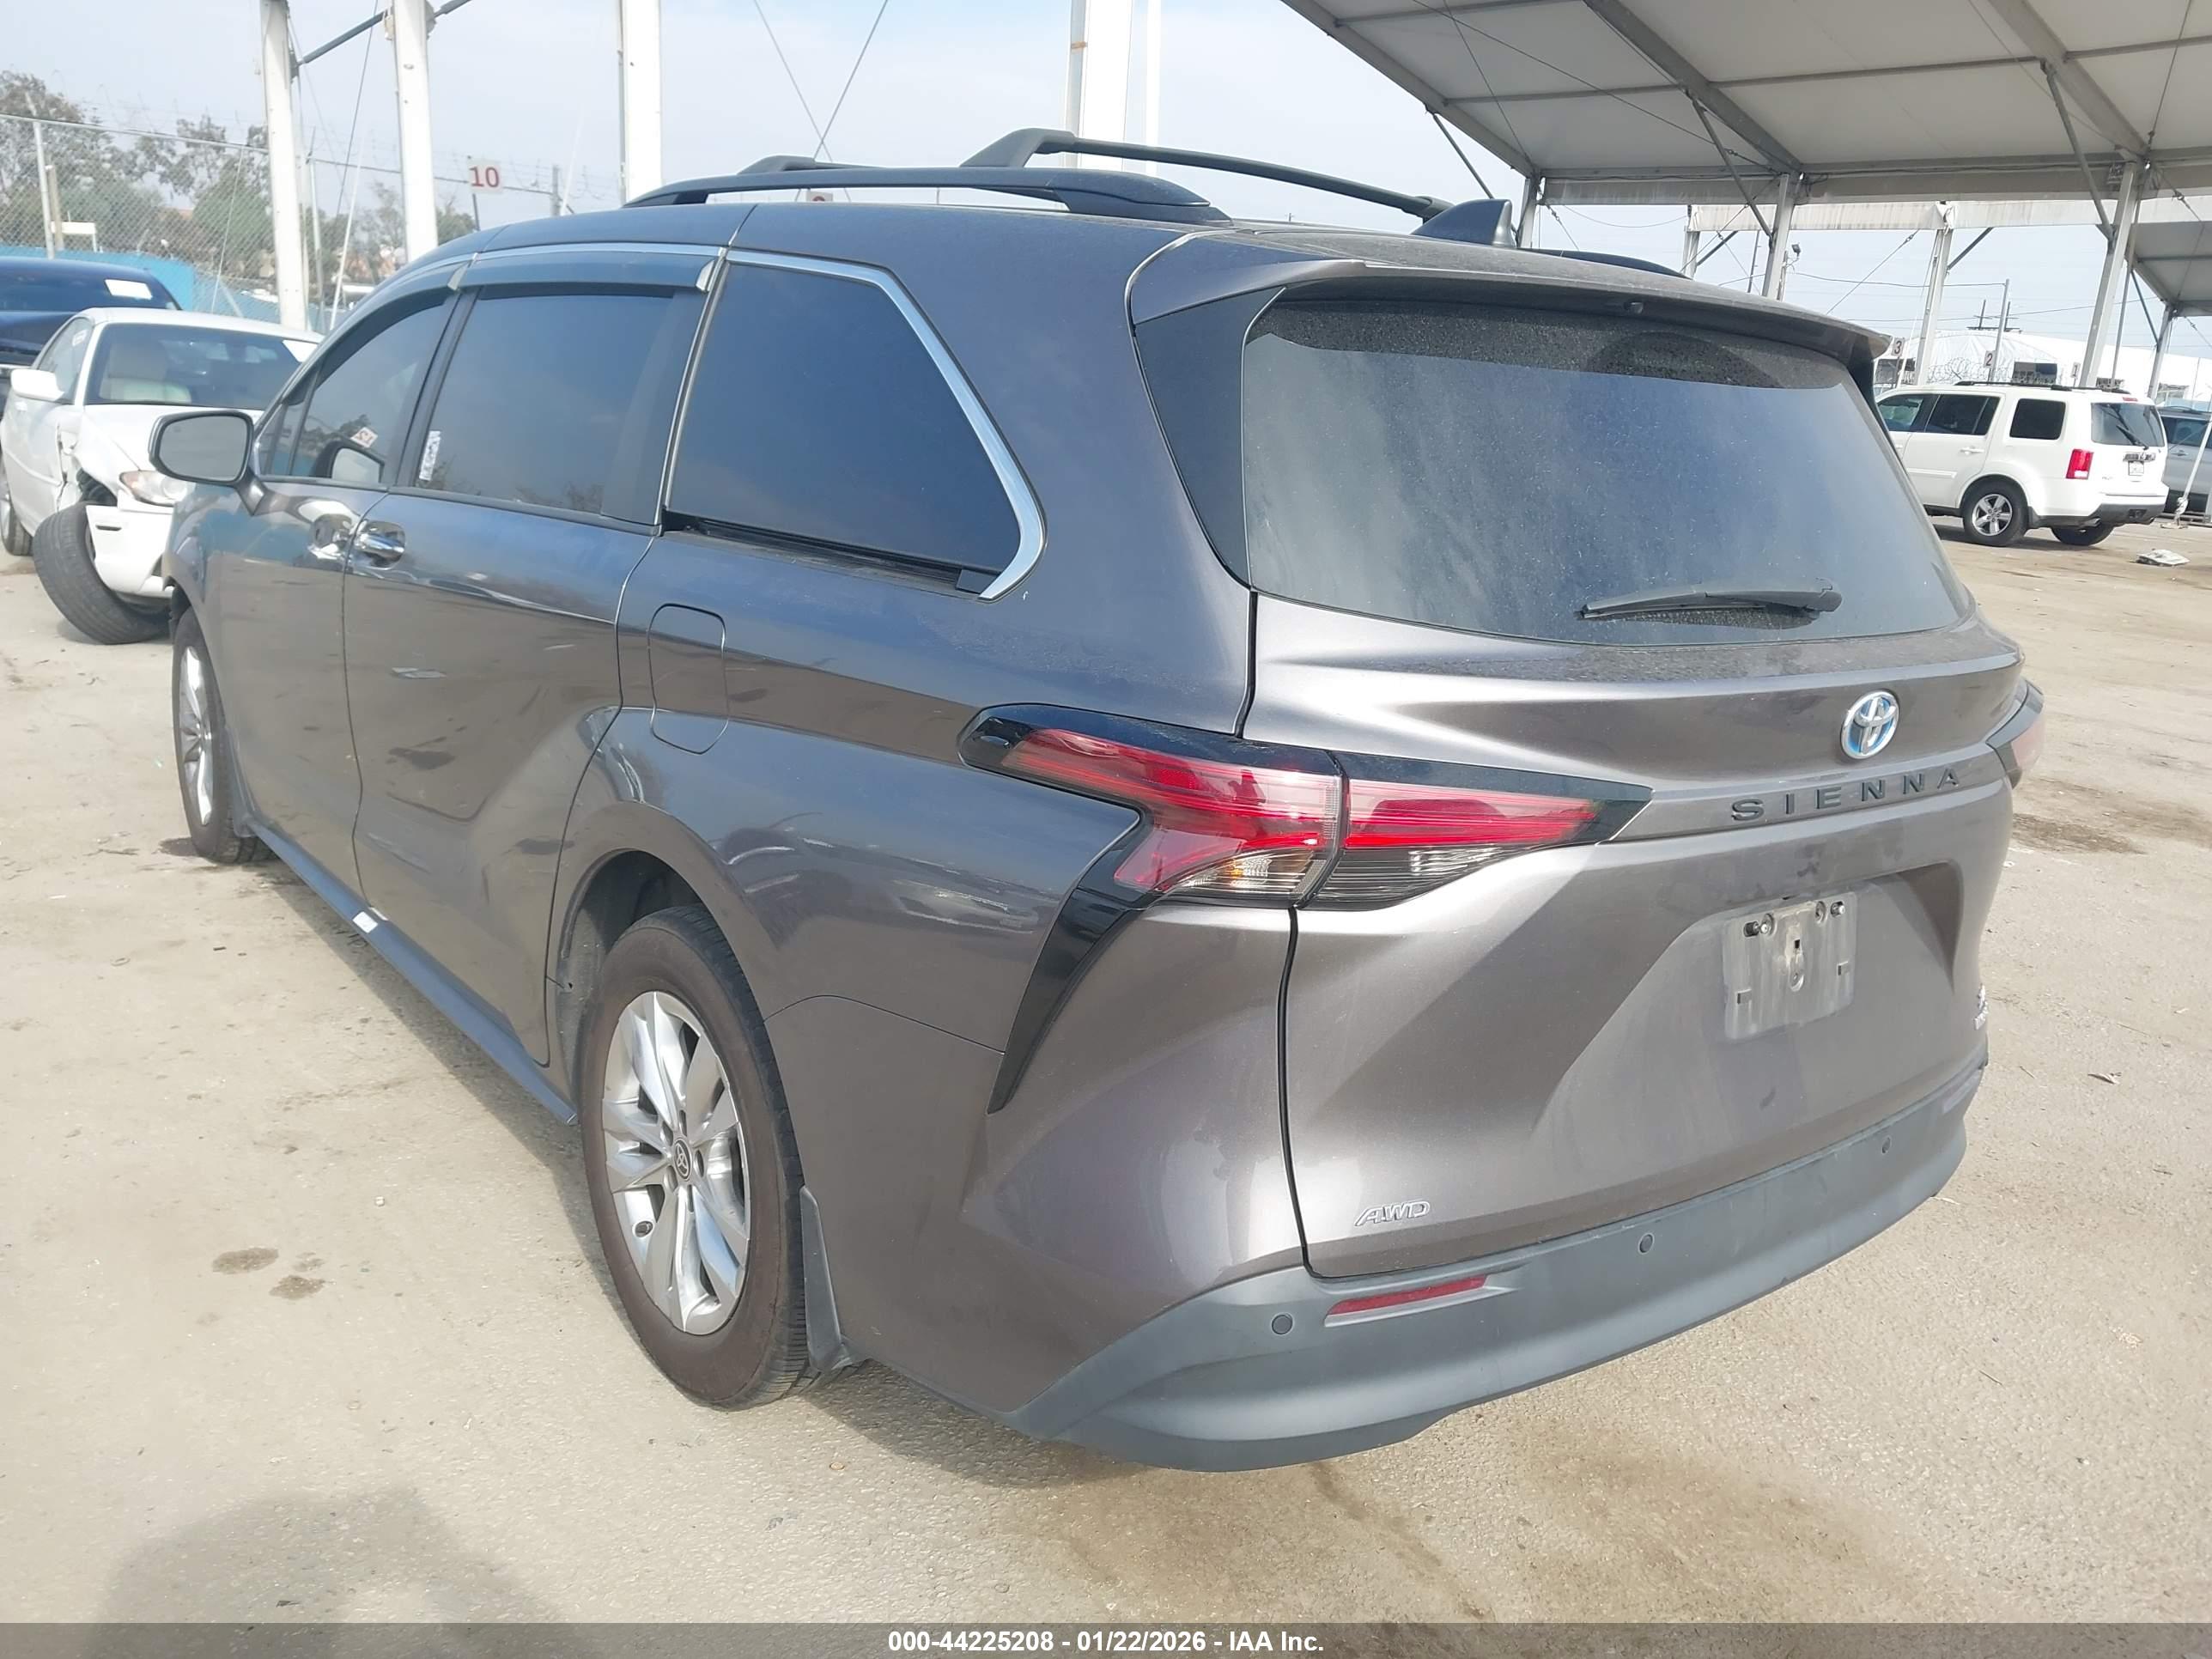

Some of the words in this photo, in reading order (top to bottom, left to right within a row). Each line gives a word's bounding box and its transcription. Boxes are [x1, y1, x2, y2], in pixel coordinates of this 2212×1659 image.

[469, 166, 500, 188] 10
[1893, 339, 1903, 355] 3
[1985, 352, 1993, 367] 2
[1731, 768, 1960, 822] SIENNA
[1354, 1200, 1431, 1227] AWD
